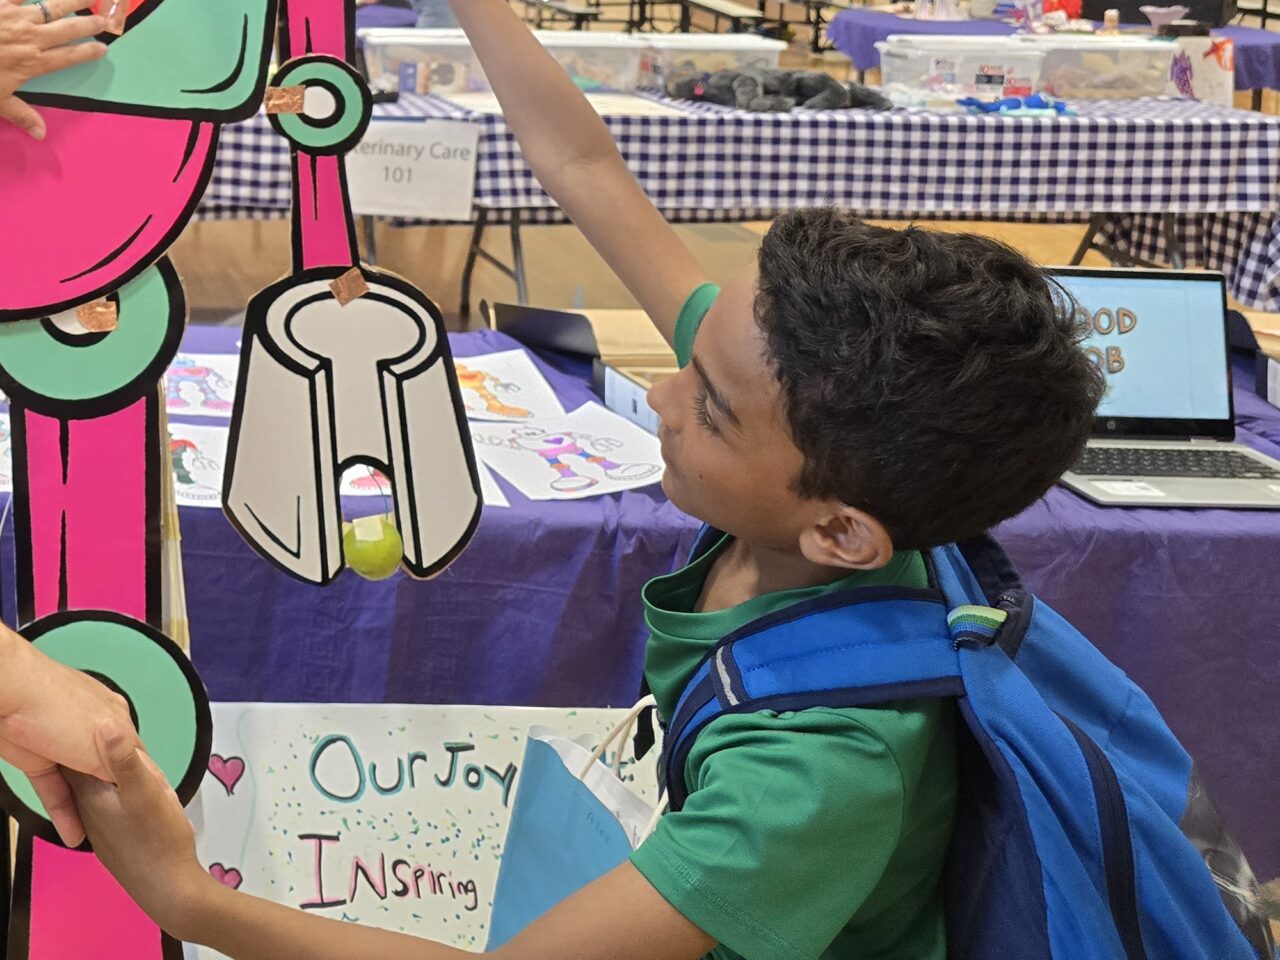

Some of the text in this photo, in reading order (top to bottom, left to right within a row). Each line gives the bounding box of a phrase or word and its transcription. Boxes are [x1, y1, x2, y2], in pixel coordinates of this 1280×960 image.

[354, 139, 471, 162] erinary Care
[383, 165, 413, 183] 101
[1071, 307, 1137, 336] OOD
[1085, 346, 1126, 374] OB
[308, 733, 427, 804] Our
